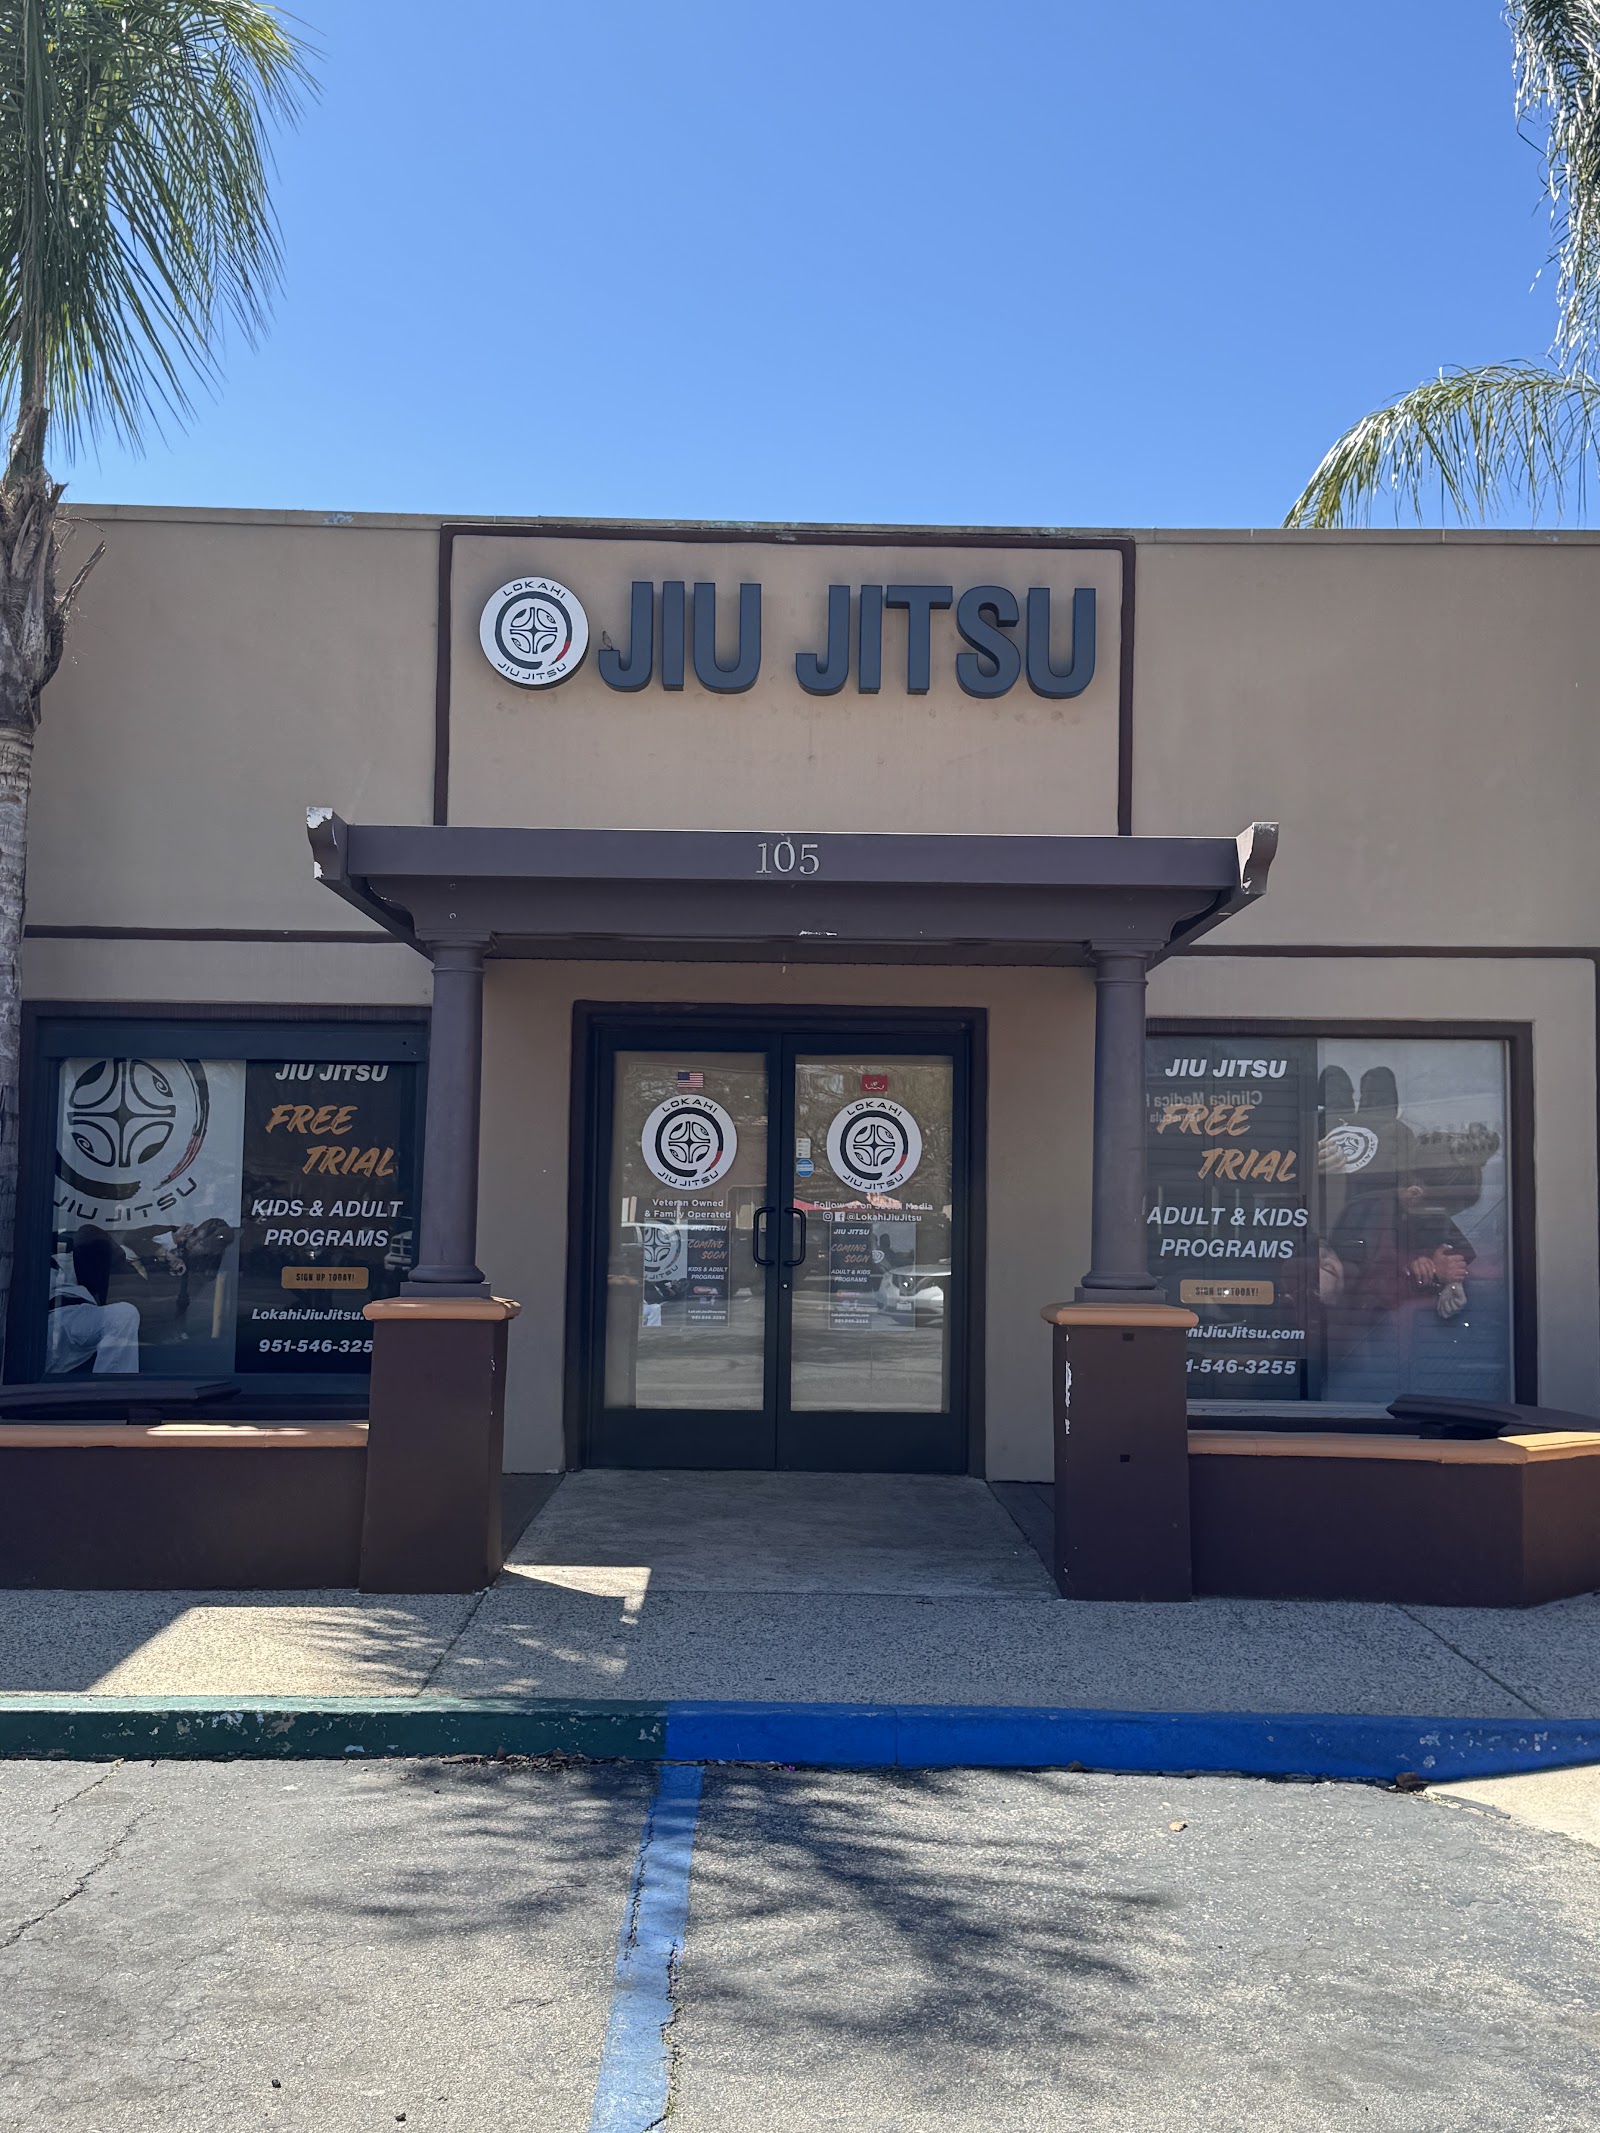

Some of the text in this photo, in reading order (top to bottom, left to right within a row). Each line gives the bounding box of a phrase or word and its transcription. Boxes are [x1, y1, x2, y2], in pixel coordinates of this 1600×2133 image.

[503, 581, 566, 598] LOKAHI
[598, 581, 1097, 699] JIU JITSU
[497, 662, 567, 680] JIU JITSU
[755, 842, 821, 876] 105
[275, 1064, 389, 1082] JIU JITSU
[1165, 1059, 1288, 1078] JIU JITSU
[662, 1098, 718, 1114] LOKAHI
[846, 1101, 903, 1117] LOKAHI
[265, 1104, 359, 1136] FREE
[1156, 1103, 1256, 1137] FREE
[302, 1145, 395, 1178] TRIAL
[1197, 1147, 1298, 1183] TRIAL
[658, 1170, 719, 1187] JIU JITSU
[842, 1173, 904, 1190] JIU JITSU
[52, 1177, 198, 1222] JIU JITSU
[652, 1198, 724, 1207] Veteran Owned
[906, 1202, 934, 1211] Media
[251, 1199, 404, 1218] KIDS & ADULT
[644, 1210, 732, 1220] & Famiy Operated
[847, 1212, 922, 1222] @LokahiJiuJitsu
[1146, 1206, 1309, 1228] ADULT & KIDS
[264, 1228, 390, 1247] PROGRAMS
[833, 1228, 870, 1236] JIU JITSU
[688, 1238, 724, 1249] COMING
[831, 1243, 868, 1253] COMING
[1160, 1238, 1295, 1260] PROGRAMS
[701, 1250, 728, 1260] SOON
[844, 1254, 871, 1264] SOON
[316, 1272, 326, 1282] UP
[1195, 1286, 1214, 1296] SIGN
[252, 1308, 365, 1321] LokahiJiuJitsu.
[258, 1339, 373, 1354] 951-546-325
[1186, 1358, 1297, 1375] 1-546-3255
